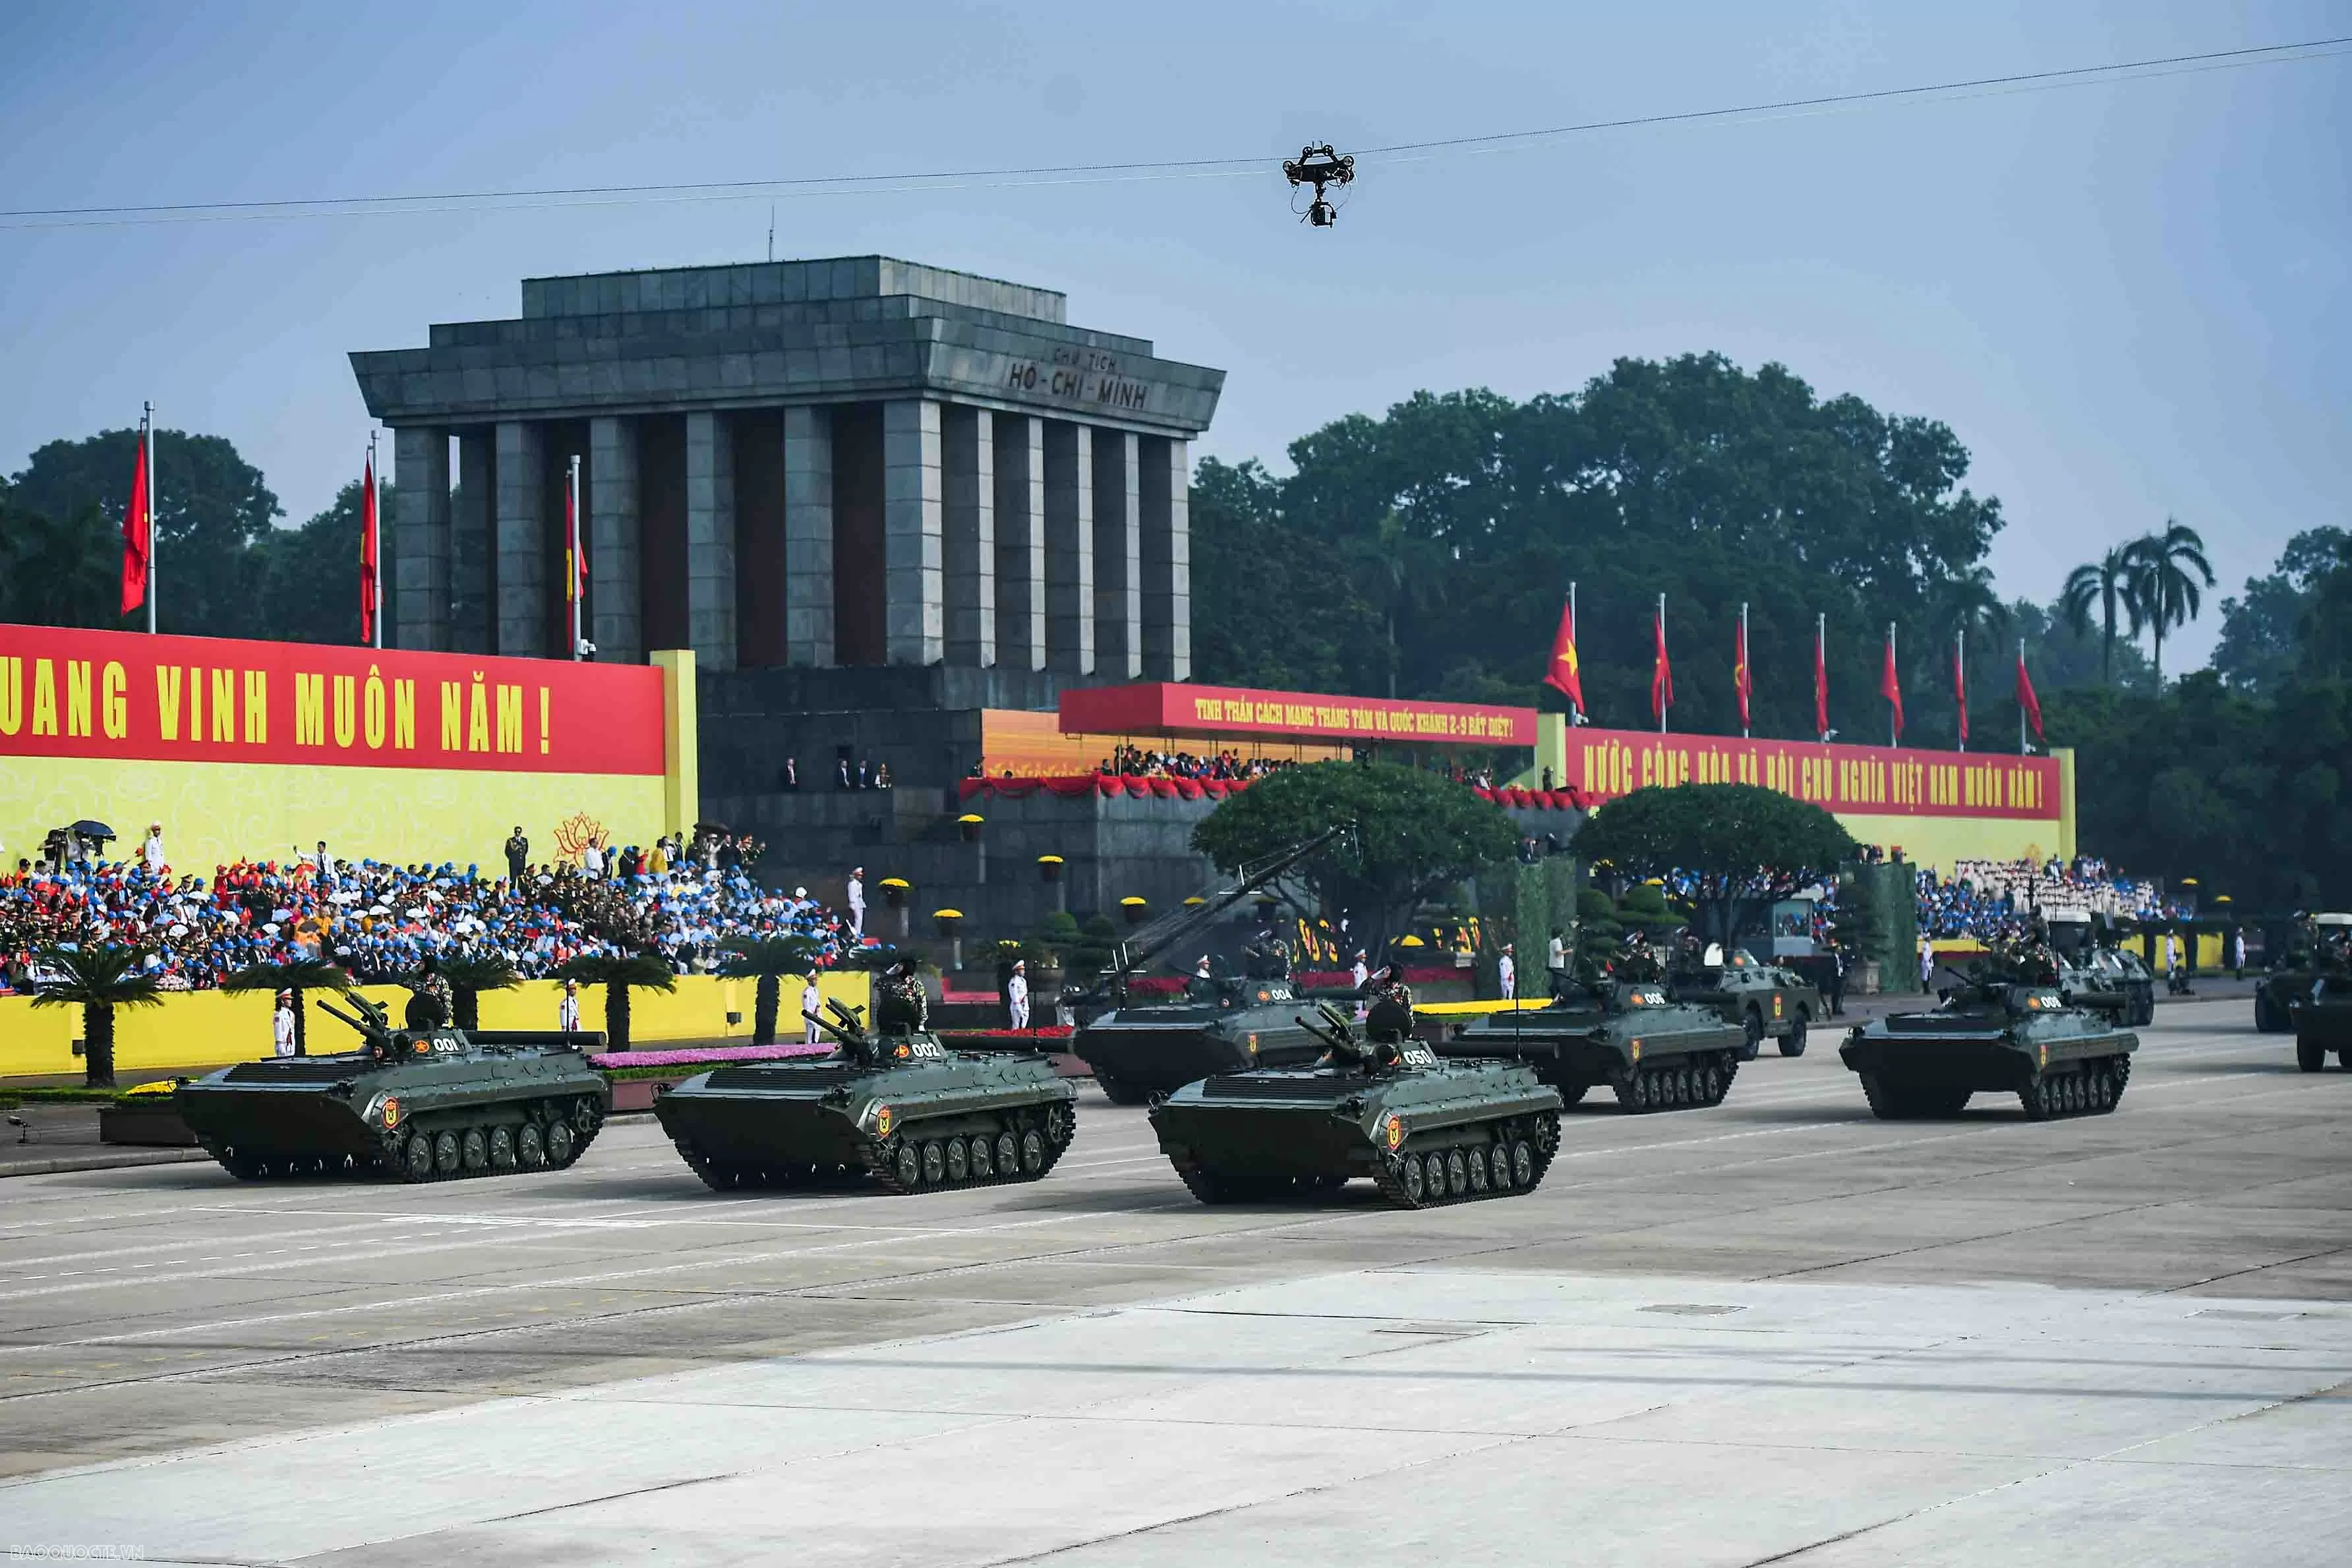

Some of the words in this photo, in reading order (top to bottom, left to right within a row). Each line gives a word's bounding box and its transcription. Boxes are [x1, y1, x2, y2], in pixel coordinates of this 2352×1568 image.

[156, 664, 267, 744] VINH
[295, 664, 415, 749] MUÔN
[1256, 699, 1283, 724] CÁCH
[1285, 703, 1314, 730] MẠNG
[1316, 704, 1349, 729] THÁNG
[1375, 707, 1388, 732] VÀ
[1390, 707, 1414, 733] QUỐC
[1417, 709, 1448, 734] KHÁNH
[1583, 738, 1632, 794] NƯỚC
[1802, 748, 1832, 801] CHỦ
[1840, 753, 1886, 803] NGHĨA
[1893, 756, 1924, 812] VIỆT
[1930, 765, 1958, 805] NAM
[1965, 761, 2002, 807] MUÔN
[1272, 989, 1293, 1000] 004
[433, 1038, 459, 1052] 001
[912, 1042, 941, 1057] 002
[1403, 1049, 1432, 1065] 050
